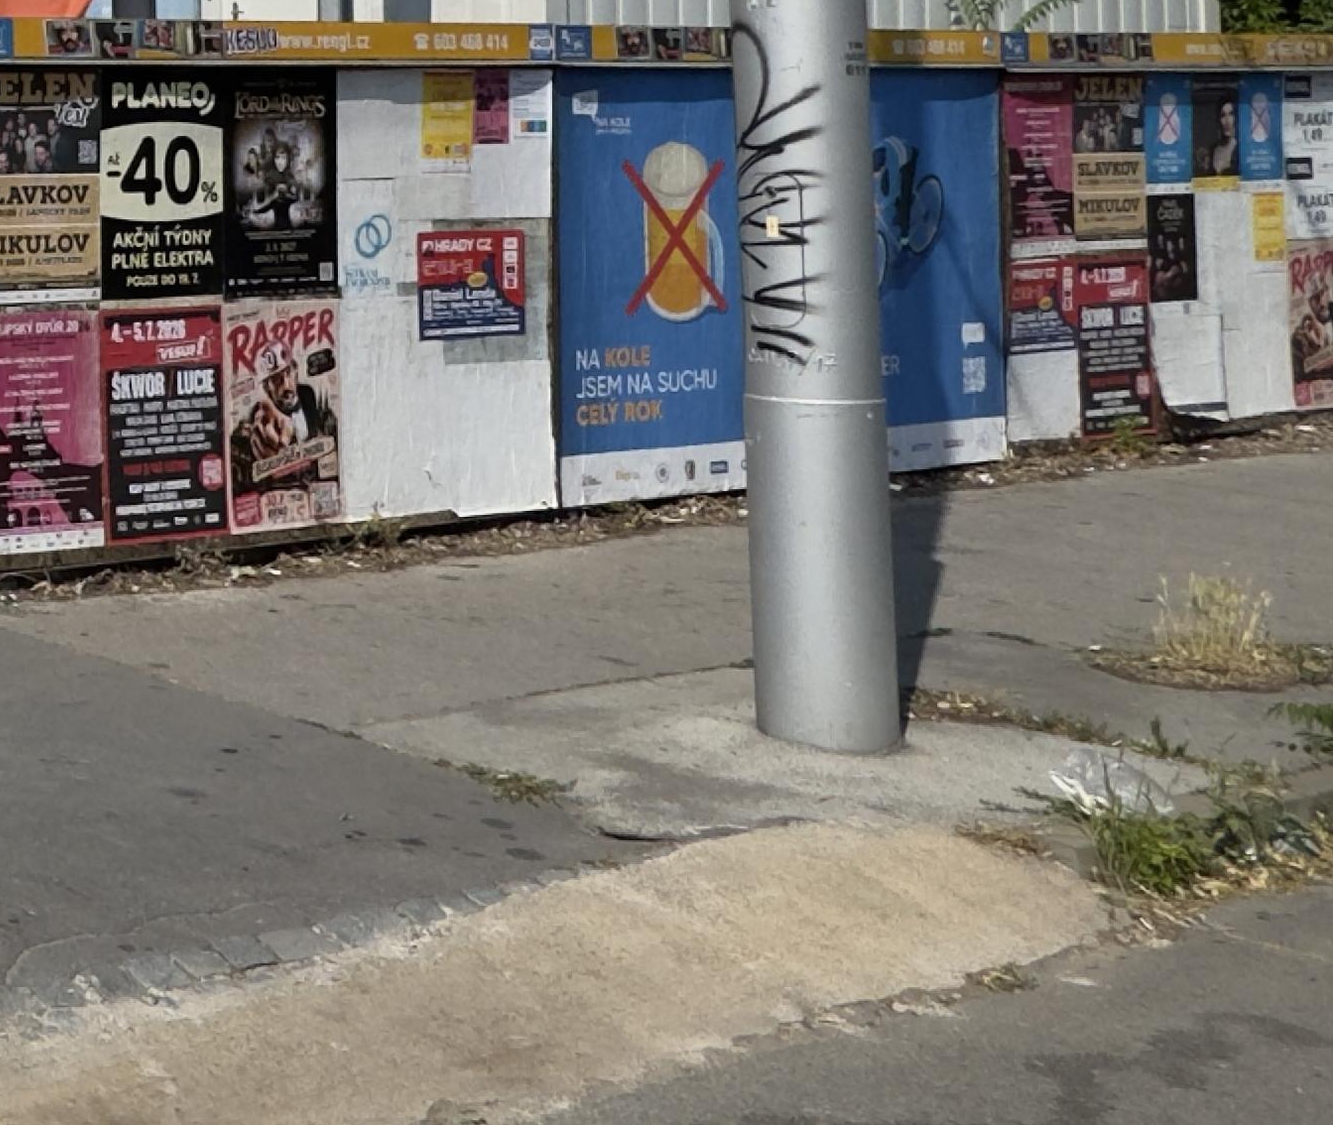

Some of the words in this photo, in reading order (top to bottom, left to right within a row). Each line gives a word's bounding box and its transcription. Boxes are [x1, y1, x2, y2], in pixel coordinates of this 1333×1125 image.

[111, 81, 213, 115] PLANEO
[113, 226, 161, 252] AKČNÍ
[164, 223, 213, 248] TÝDNY
[153, 249, 214, 268] ELEKTRA
[227, 308, 335, 377] RAPPER
[576, 348, 601, 371] NA
[604, 345, 652, 368] KOLE
[881, 355, 901, 375] ER
[576, 375, 623, 398] JSEM
[627, 372, 654, 395] NA
[657, 369, 718, 393] SUCHU
[576, 398, 619, 426] CELÝ
[624, 399, 664, 422] ROK
